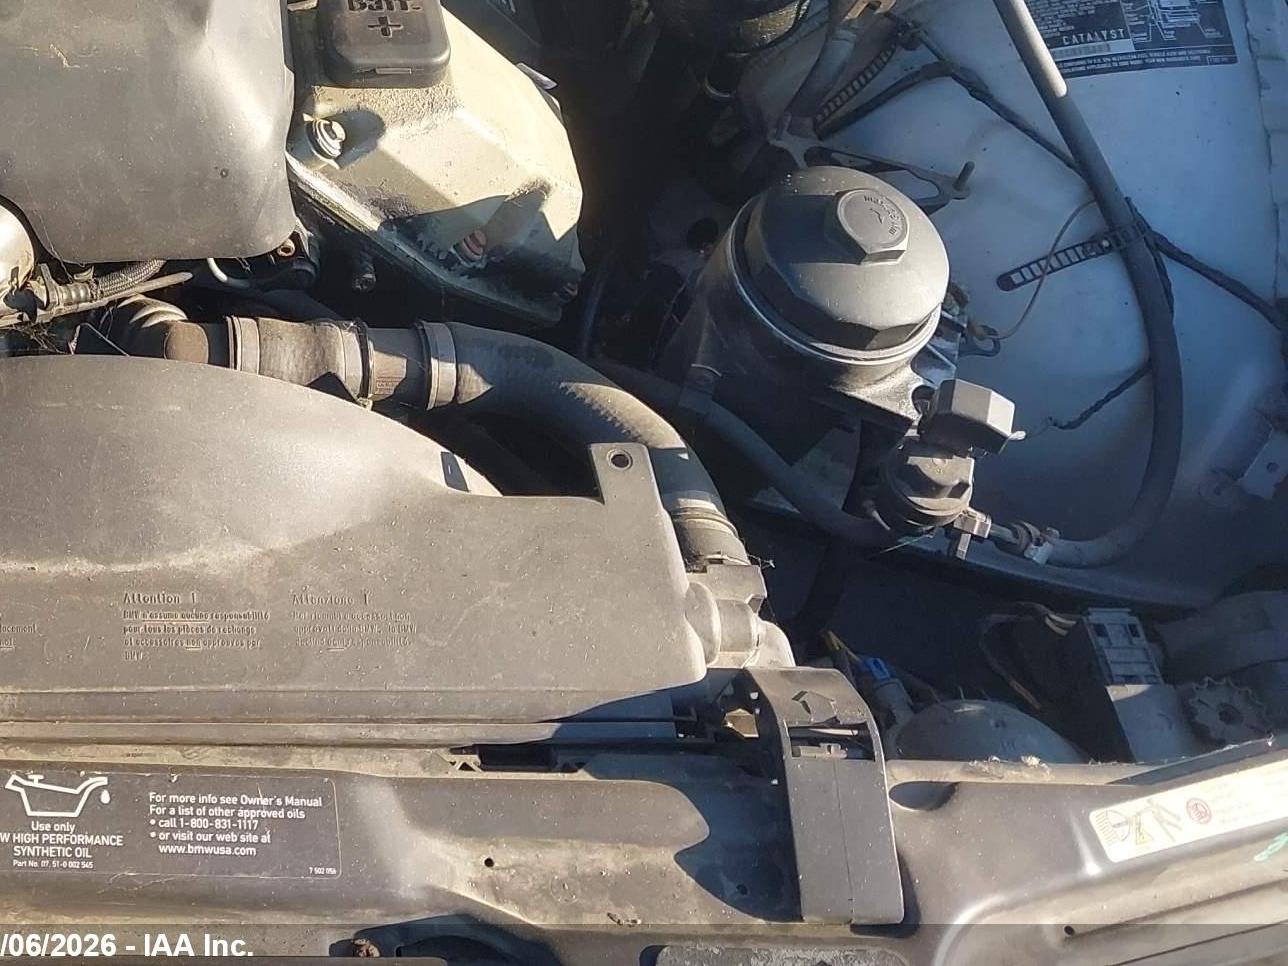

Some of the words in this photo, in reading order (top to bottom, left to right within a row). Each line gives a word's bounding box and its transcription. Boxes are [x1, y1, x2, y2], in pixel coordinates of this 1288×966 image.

[1062, 28, 1125, 46] CATALYST
[123, 592, 181, 605] Attention
[150, 792, 166, 803] For
[169, 795, 196, 804] more
[198, 794, 217, 804] info
[220, 796, 238, 805] see
[240, 794, 282, 806] Owner's
[285, 796, 322, 807] Manual
[150, 805, 167, 815] For
[169, 807, 176, 815] a
[178, 806, 194, 816] list
[196, 806, 207, 816] of
[208, 806, 235, 817] other
[237, 808, 285, 820] approved
[287, 809, 305, 819] oils
[31, 821, 51, 831] Use
[54, 822, 76, 834] only
[158, 818, 177, 828] call
[179, 818, 258, 830] 1-800-831-1117
[13, 833, 39, 844] HIGH
[42, 834, 124, 846] PERFORMANCE
[158, 833, 171, 841] or
[172, 831, 194, 842] visit
[196, 833, 213, 842] our
[215, 831, 237, 843] web
[239, 832, 258, 843] site
[261, 833, 271, 843] at
[13, 846, 72, 857] SYNTHETIC
[75, 847, 92, 858] OIL
[158, 844, 257, 856] www.bmwusa.com
[13, 859, 27, 867] Part
